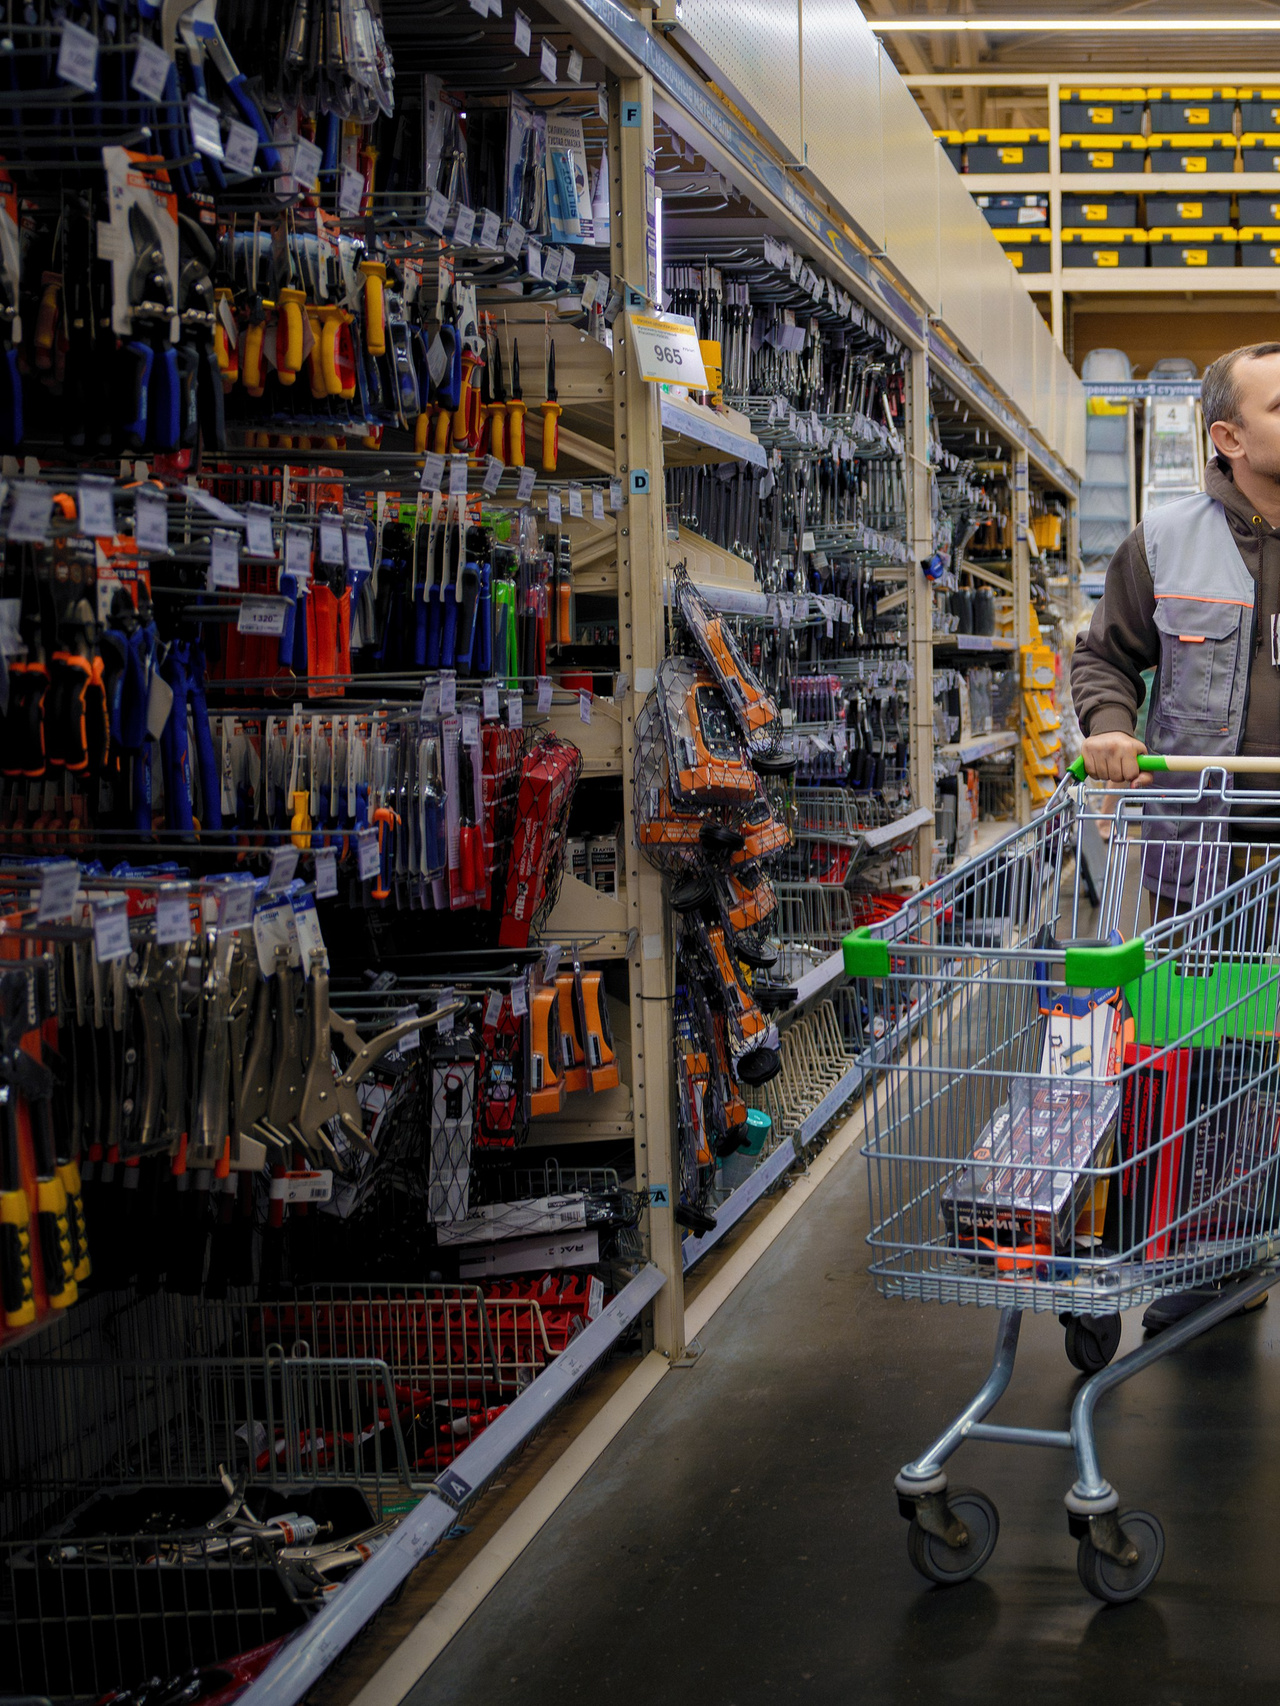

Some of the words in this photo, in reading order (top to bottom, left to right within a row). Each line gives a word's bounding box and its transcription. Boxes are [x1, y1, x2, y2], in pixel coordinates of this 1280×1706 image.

[651, 42, 693, 100] Смазочные
[691, 90, 732, 141] материалы
[627, 109, 637, 121] F
[547, 125, 580, 136] СИЛИКОНОВАЯ
[564, 138, 581, 148] СМАЗКА
[563, 168, 577, 217] SILICOT
[630, 292, 641, 305] E
[654, 344, 683, 365] 965
[1137, 384, 1156, 395] 4-5
[1168, 408, 1177, 420] 4
[633, 475, 647, 490] D
[99, 568, 136, 579] DEXTER
[982, 1112, 1010, 1149] ВИХРЬ
[654, 1191, 667, 1203] A
[958, 1214, 1022, 1232] ВИХРЬ
[450, 1479, 467, 1497] A
